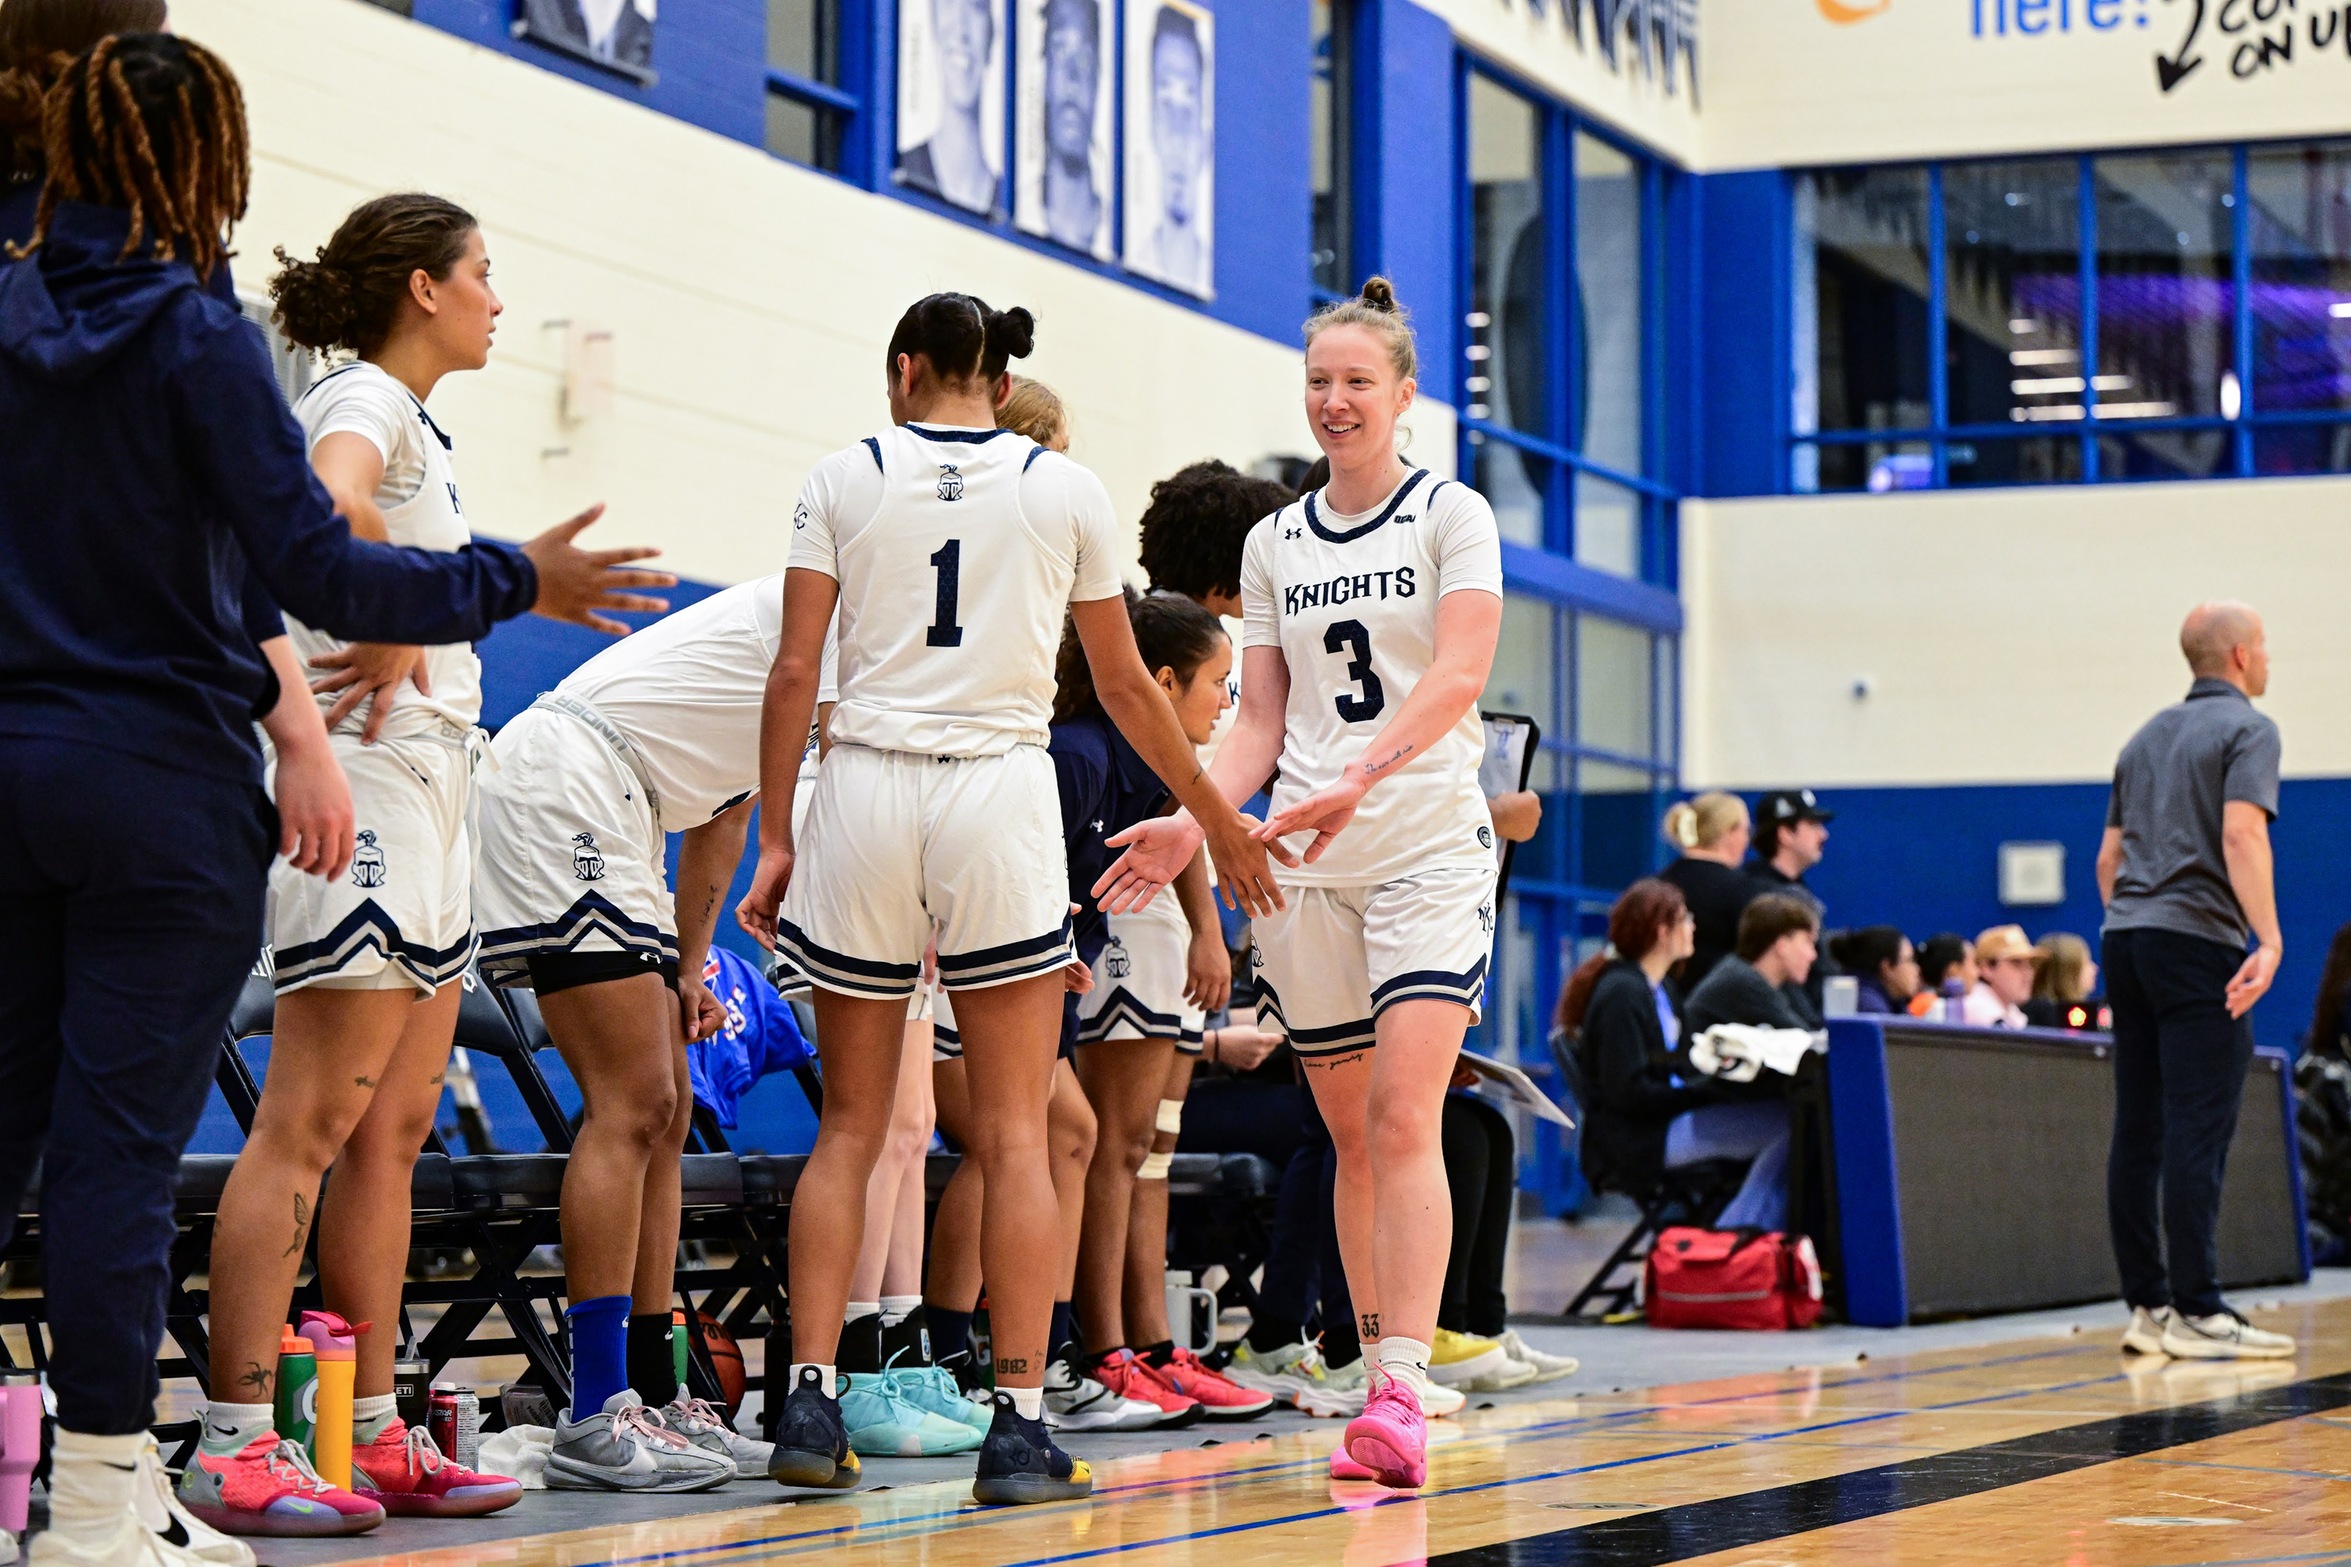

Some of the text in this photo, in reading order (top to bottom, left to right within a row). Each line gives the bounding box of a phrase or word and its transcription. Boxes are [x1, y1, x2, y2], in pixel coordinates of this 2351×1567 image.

[2232, 6, 2351, 78] ON U
[926, 538, 964, 647] 1
[1284, 566, 1416, 617] KNIGHTS
[1323, 618, 1385, 724] 3
[1361, 1313, 1380, 1338] 33
[393, 1386, 412, 1395] ETI
